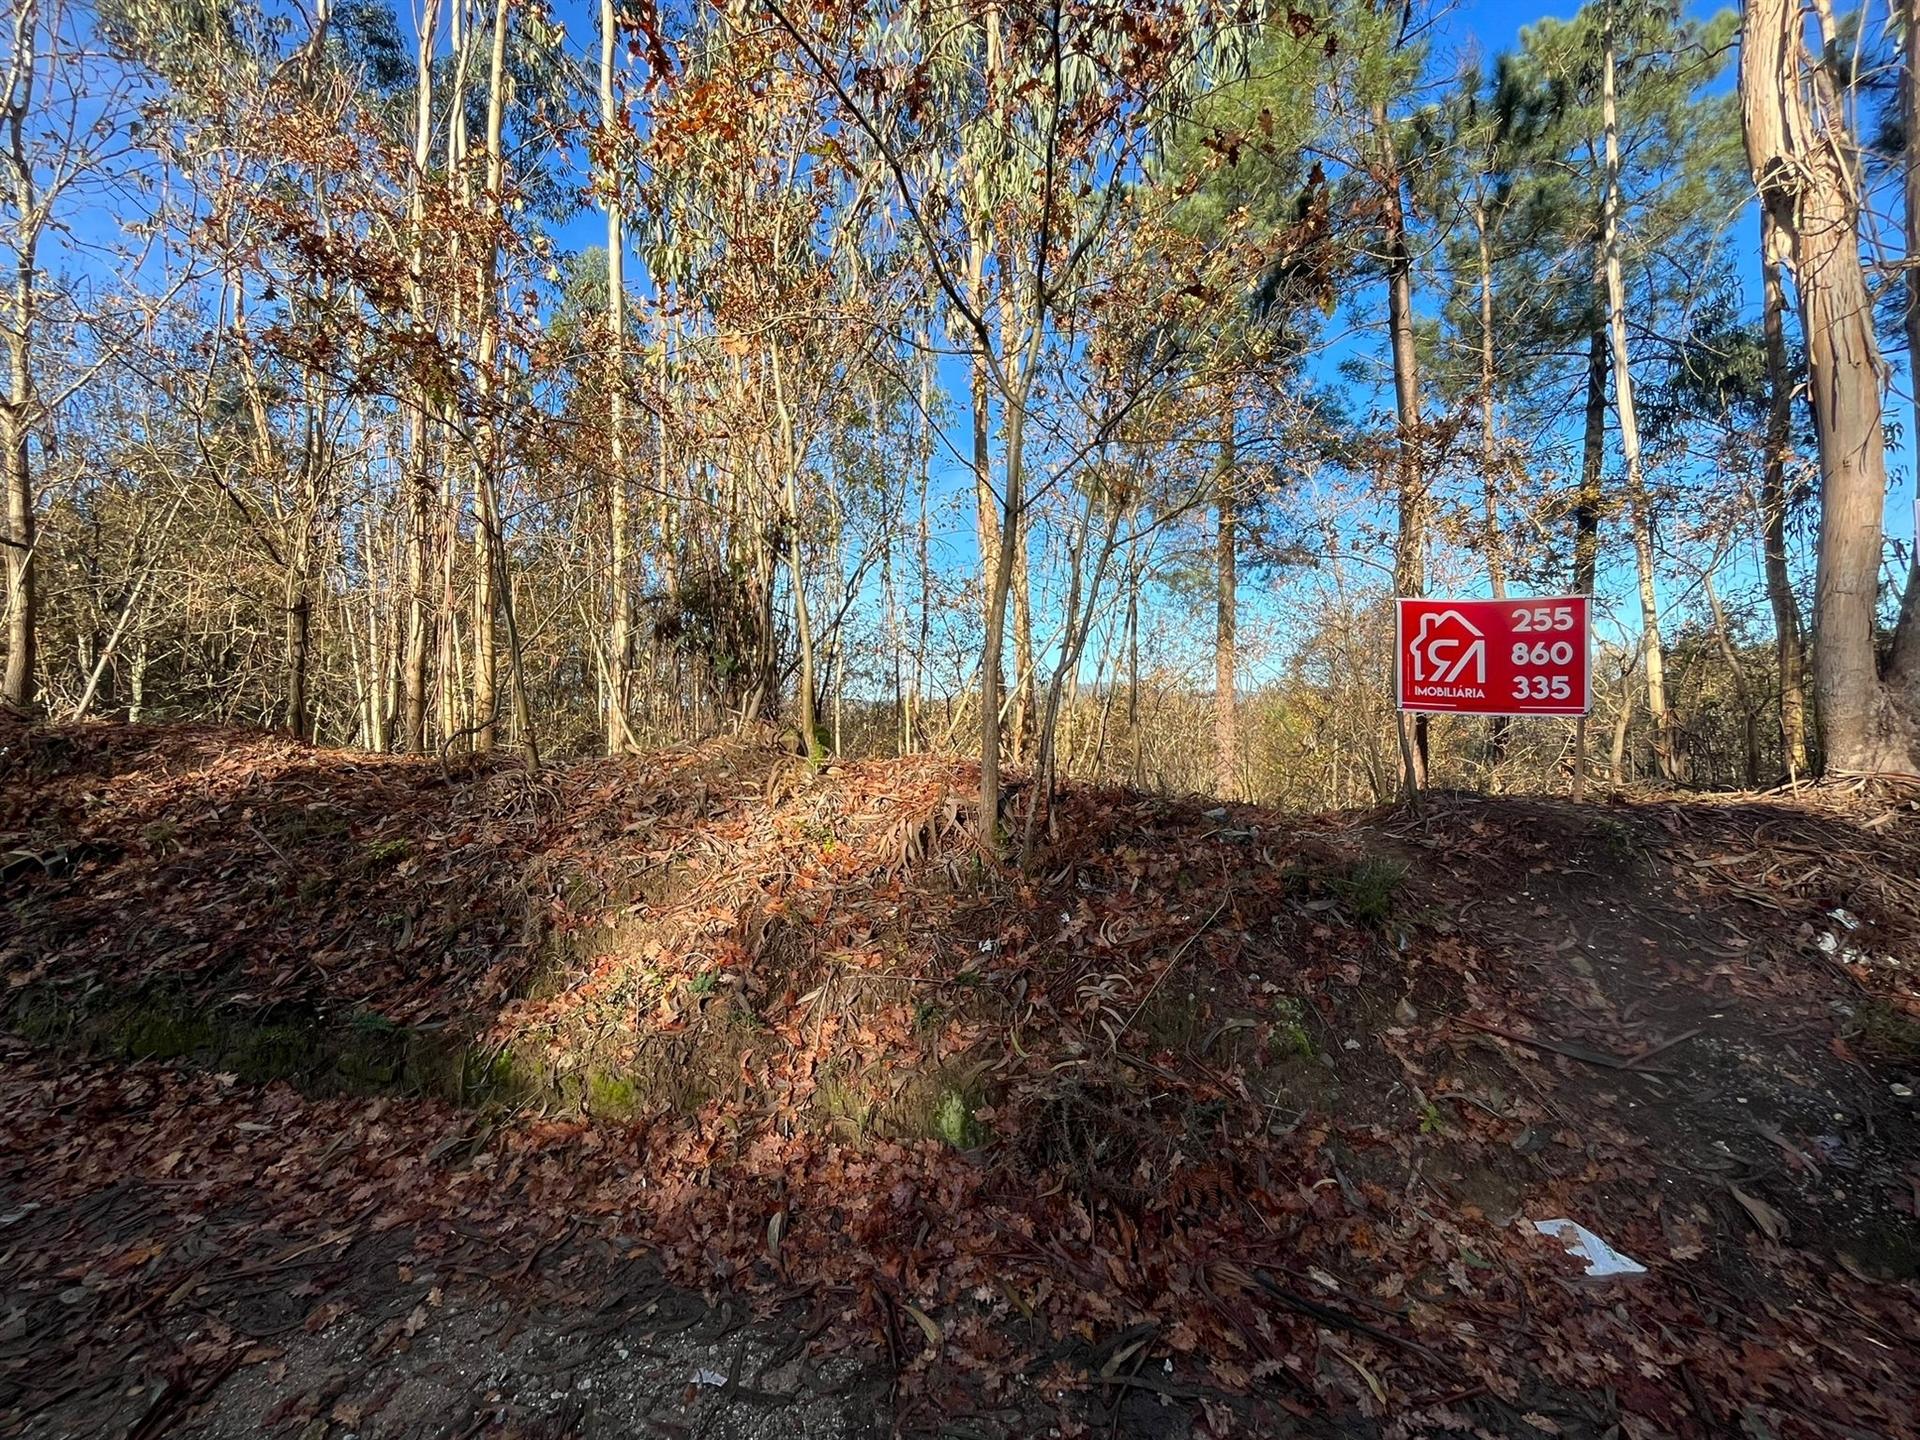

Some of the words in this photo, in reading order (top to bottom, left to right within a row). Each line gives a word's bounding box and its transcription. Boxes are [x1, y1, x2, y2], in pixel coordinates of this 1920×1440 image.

[1511, 607, 1573, 632] 255
[1511, 641, 1573, 666] 860
[1414, 685, 1485, 699] IMOBILIÁRIA
[1511, 676, 1571, 700] 335
